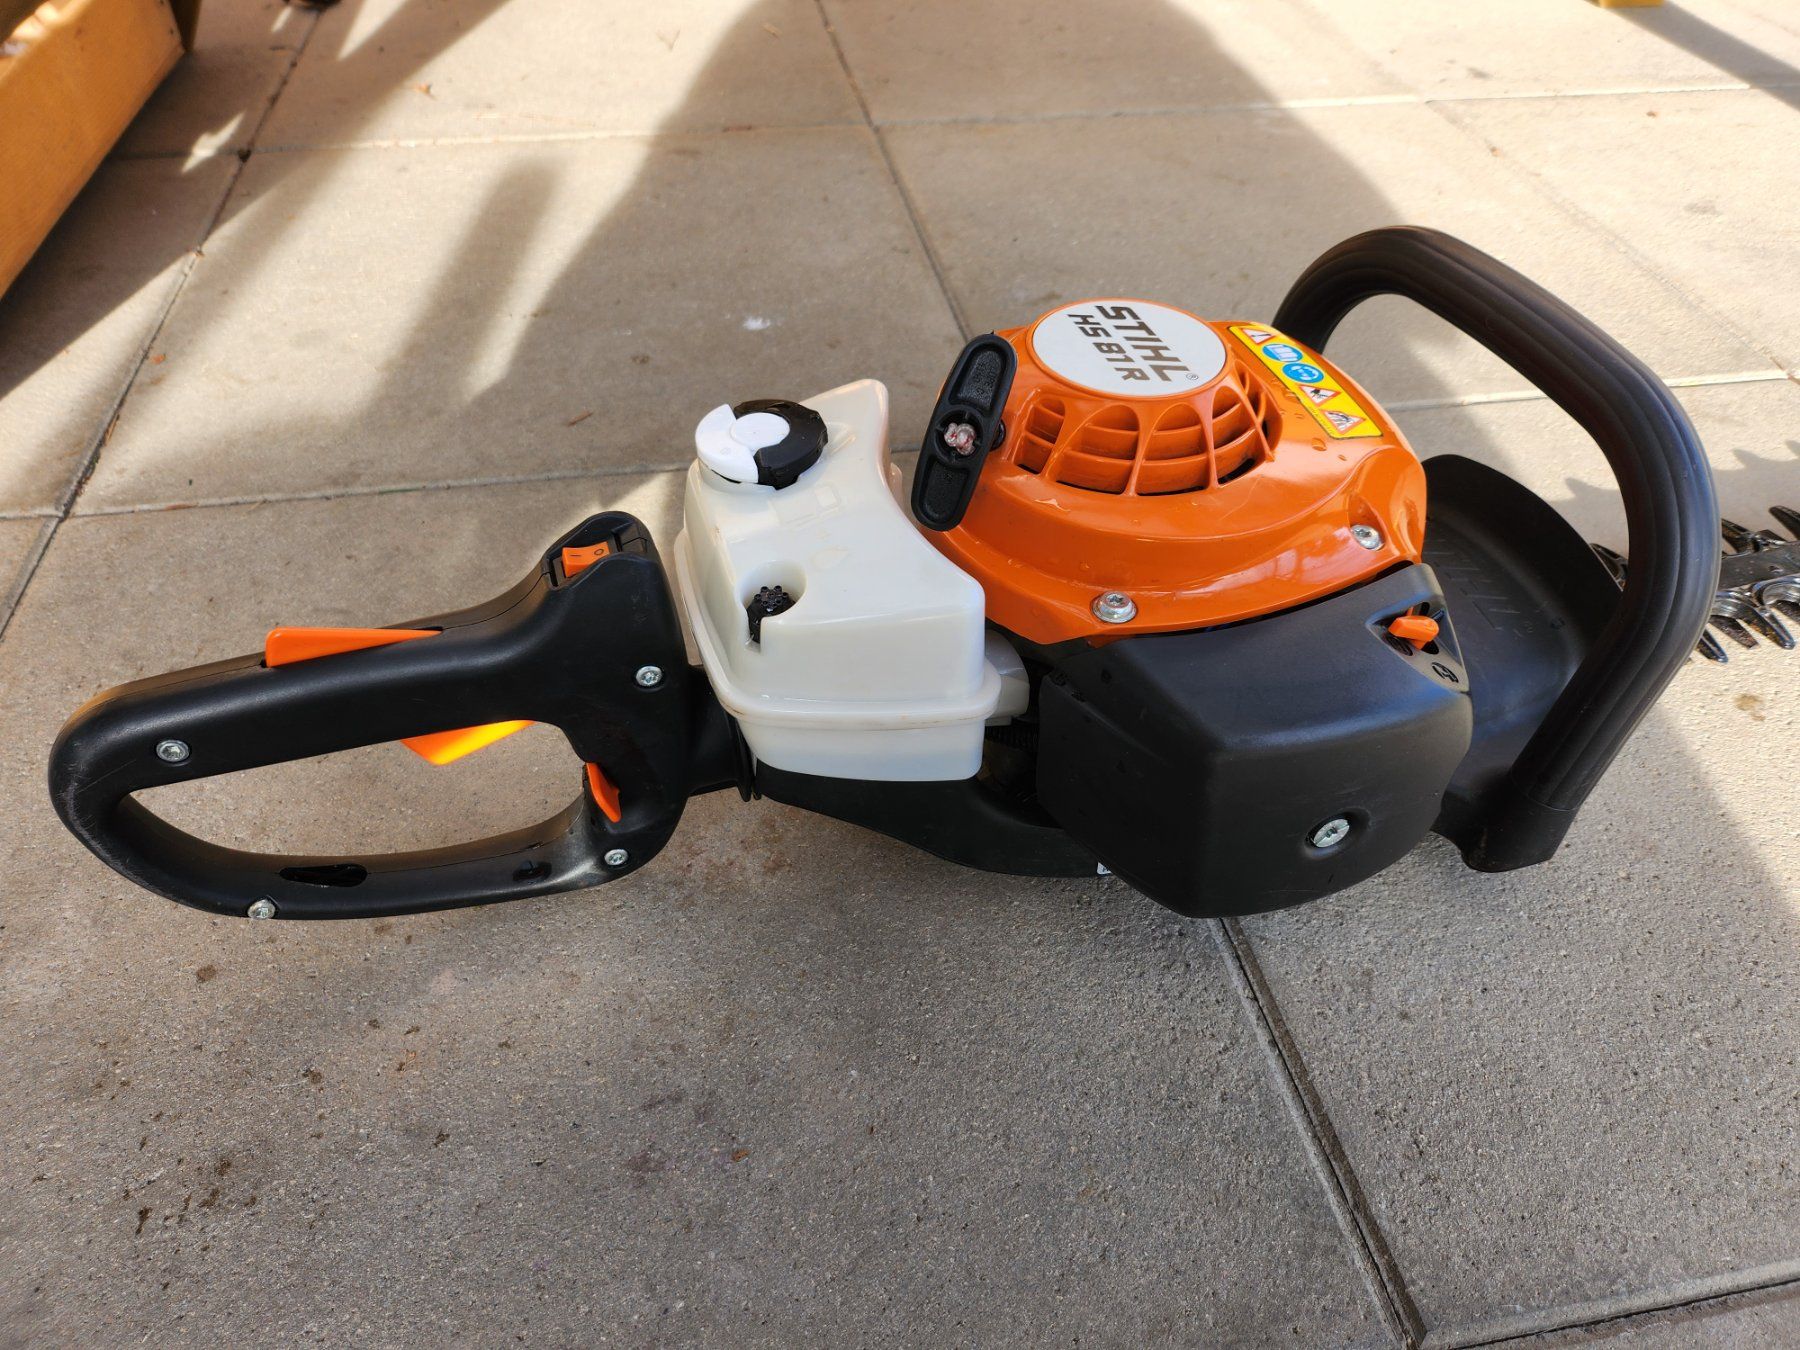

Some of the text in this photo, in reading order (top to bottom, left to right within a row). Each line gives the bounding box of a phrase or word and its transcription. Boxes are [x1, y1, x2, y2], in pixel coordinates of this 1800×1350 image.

[1067, 314, 1150, 381] HS 81 R
[1095, 306, 1190, 381] STIHL
